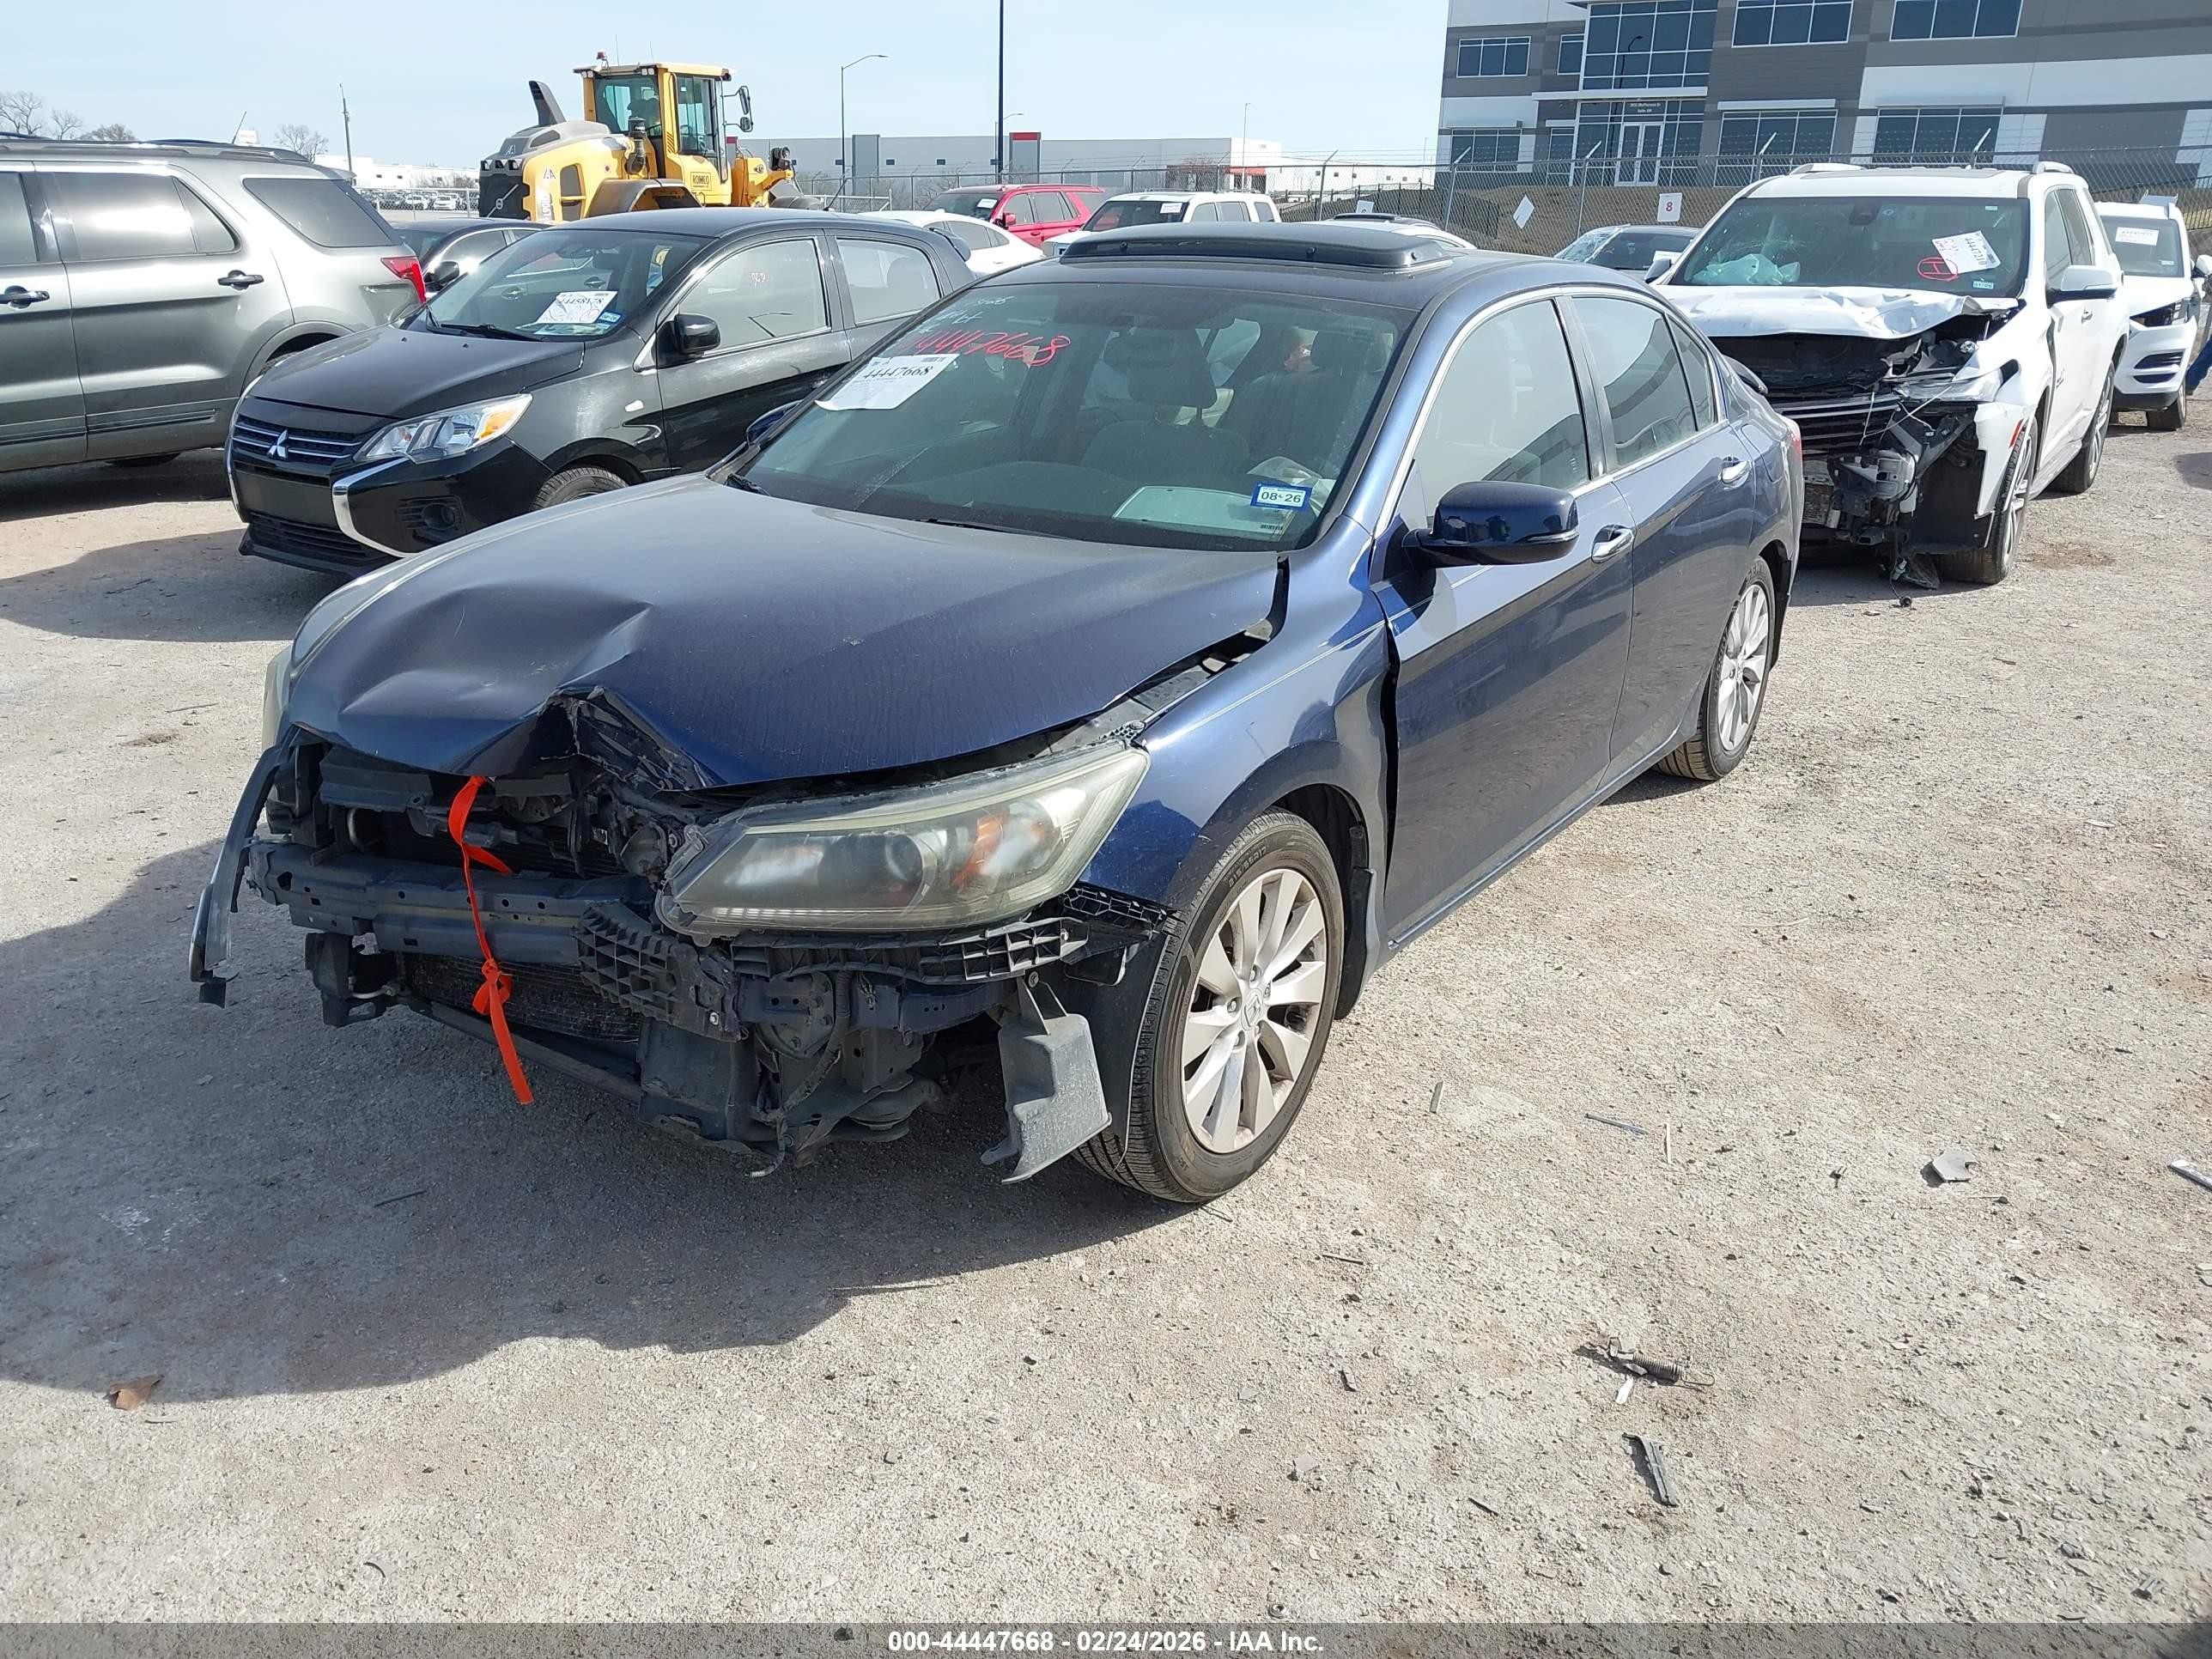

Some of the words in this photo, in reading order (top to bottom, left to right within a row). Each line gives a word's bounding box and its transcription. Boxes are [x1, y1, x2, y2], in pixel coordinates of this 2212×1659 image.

[1666, 201, 1674, 212] 8
[862, 365, 934, 380] 44447668
[1261, 491, 1278, 501] 08
[1284, 494, 1302, 503] 26
